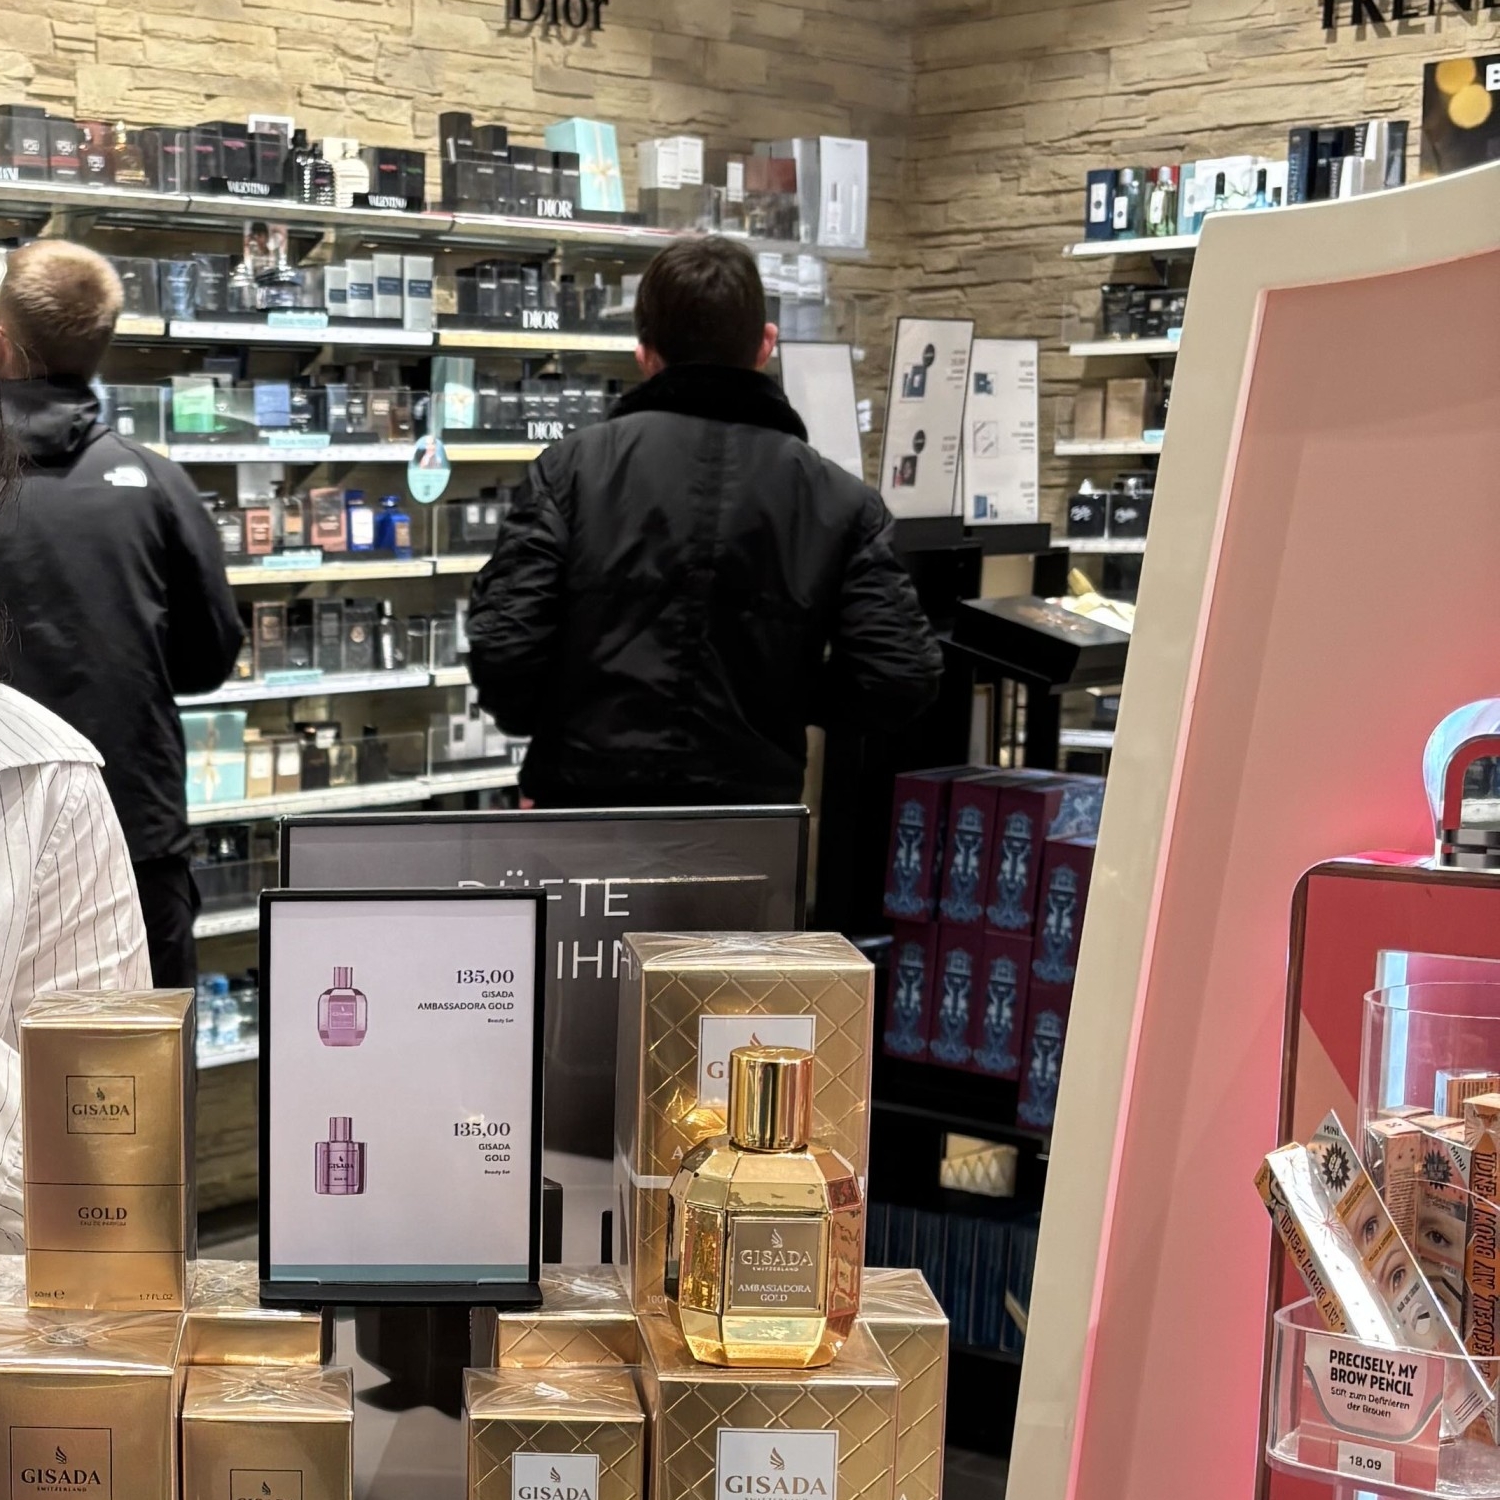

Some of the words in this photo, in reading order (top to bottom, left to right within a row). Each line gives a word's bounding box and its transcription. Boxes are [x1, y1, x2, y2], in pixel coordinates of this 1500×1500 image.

[537, 198, 573, 219] DIOR
[522, 309, 559, 330] DIOR
[527, 421, 564, 440] DIOR
[456, 969, 514, 985] 135,00
[418, 1002, 486, 1010] AMBASSADORA
[488, 1002, 514, 1010] GOLD
[72, 1103, 130, 1117] GISADA
[453, 1122, 511, 1138] 135,00
[484, 1154, 510, 1162] GOLD
[1450, 1146, 1467, 1172] MINI
[78, 1207, 127, 1220] GOLD
[740, 1250, 813, 1267] GISADA
[737, 1283, 811, 1293] AMBASSADORA
[760, 1294, 788, 1302] GOLD
[1329, 1349, 1396, 1377] PRECISELY,
[1398, 1363, 1418, 1380] MY
[1330, 1366, 1366, 1388] BROW
[1370, 1373, 1414, 1397] PENCIL
[1330, 1386, 1347, 1398] Stift
[1349, 1391, 1367, 1402] zum
[1368, 1394, 1410, 1410] Definieren
[1346, 1402, 1360, 1412] der
[1362, 1404, 1391, 1418] Brauen
[1348, 1455, 1382, 1471] 18,09
[21, 1468, 101, 1485] GISADA
[725, 1475, 827, 1495] GISADA
